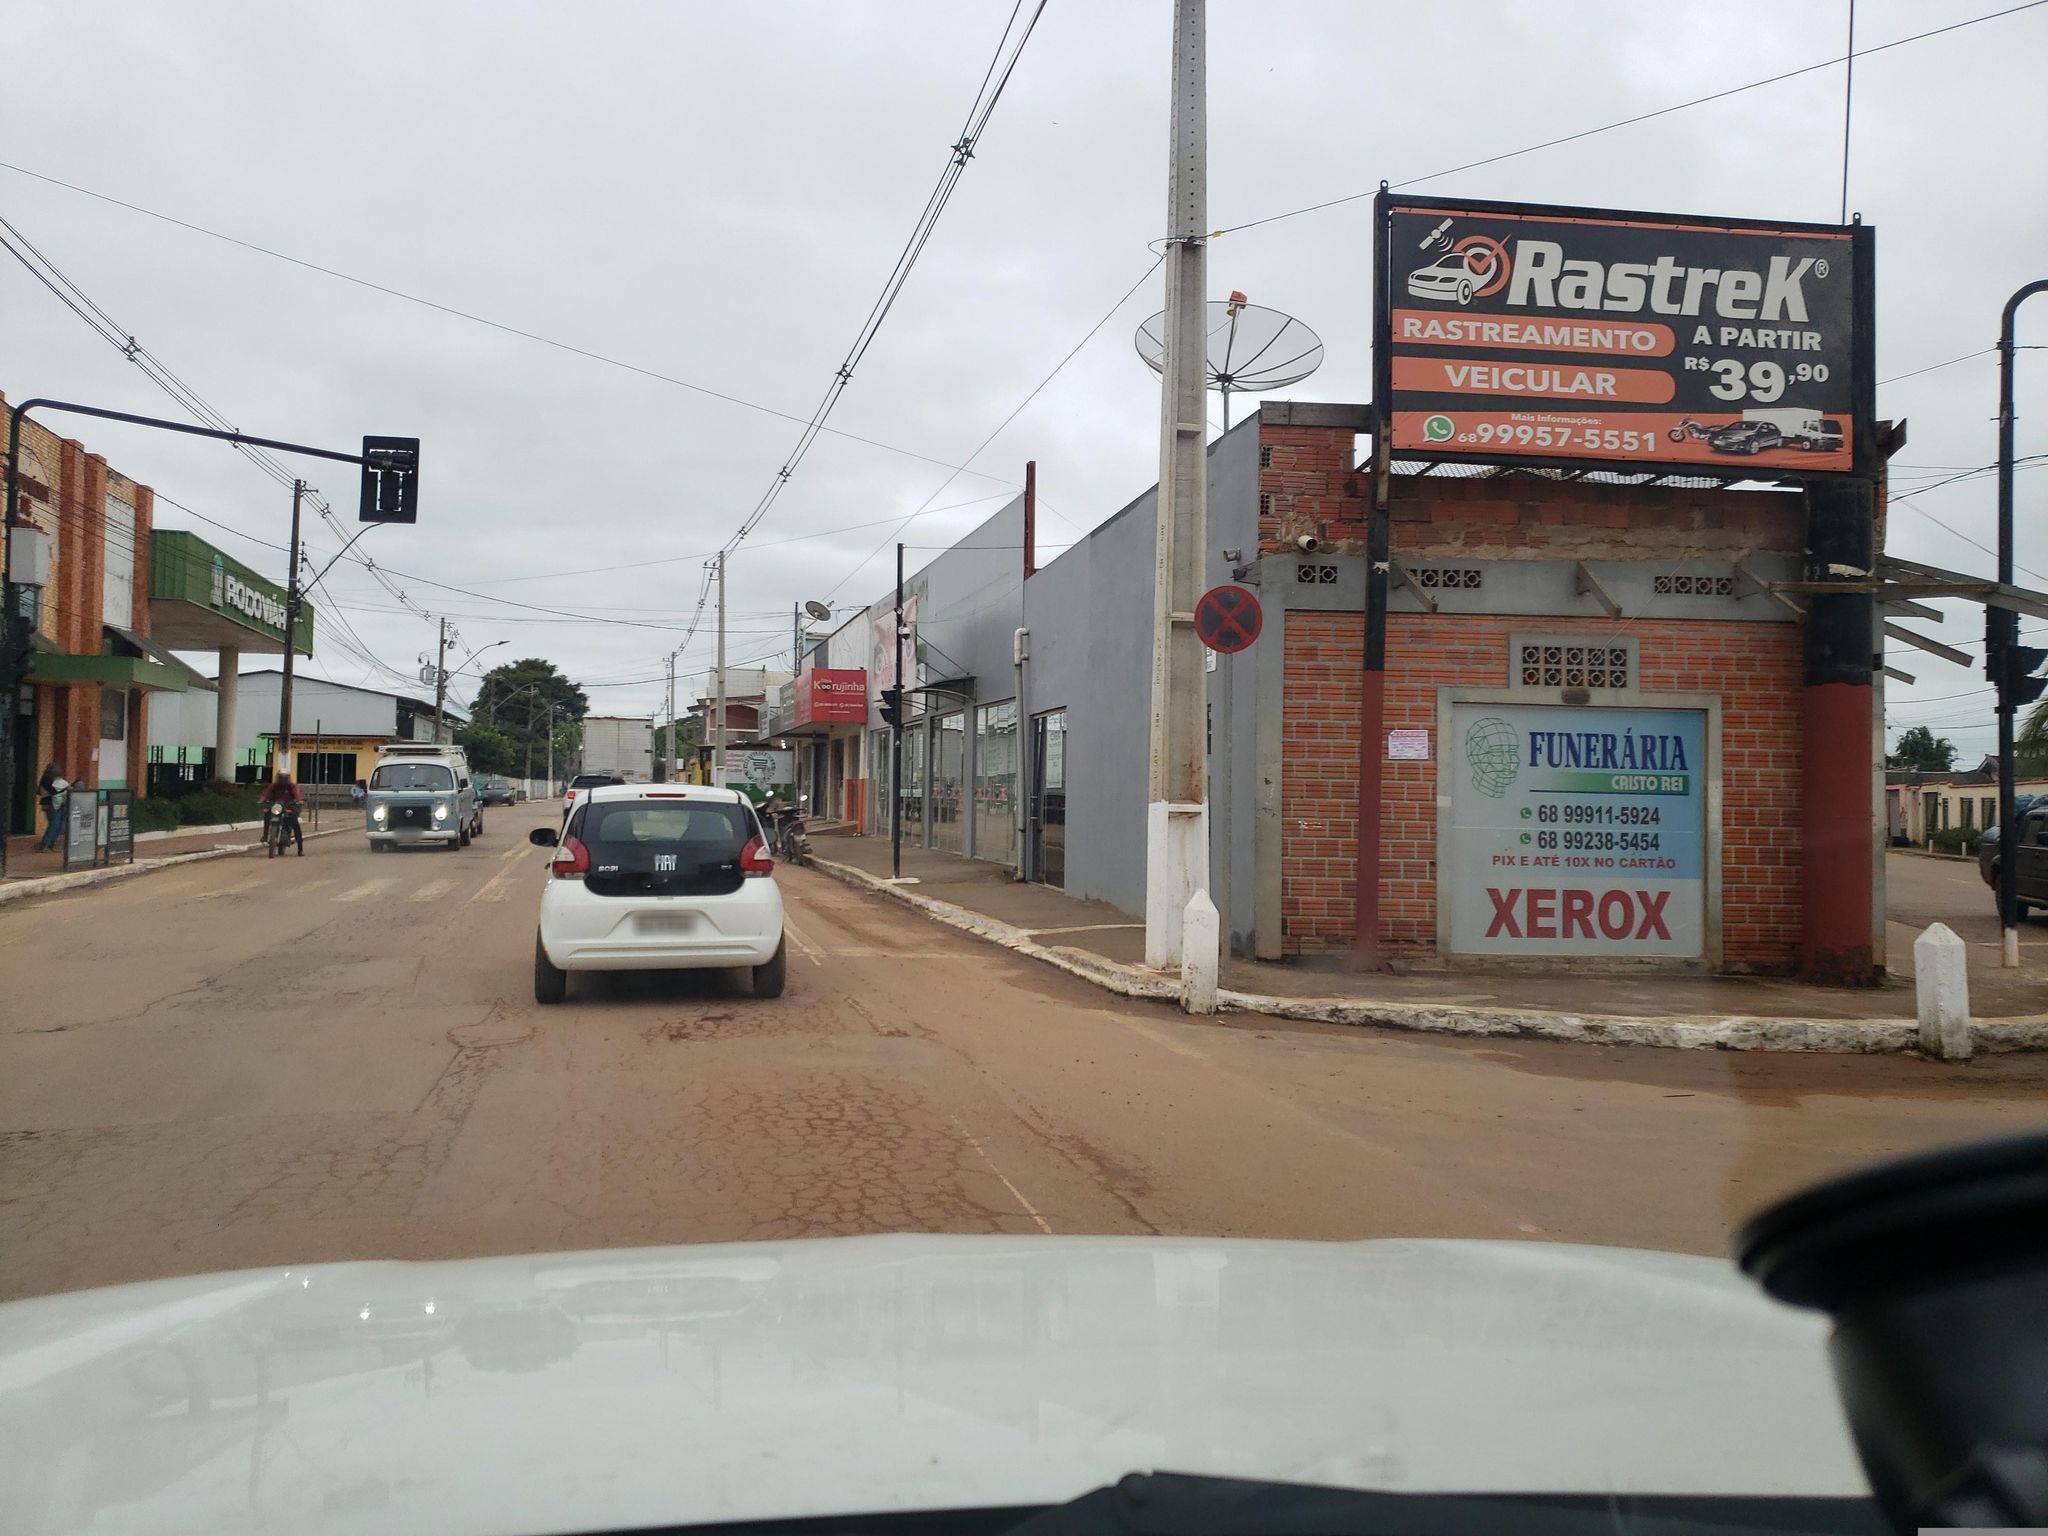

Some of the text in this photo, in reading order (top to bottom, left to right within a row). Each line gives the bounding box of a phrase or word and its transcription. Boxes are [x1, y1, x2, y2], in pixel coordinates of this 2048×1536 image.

[1403, 318, 1656, 351] RASTREAMENTO
[1692, 325, 1822, 350] A PARTIR
[1444, 365, 1617, 395] VEICULAR
[1511, 413, 1535, 422] Mais
[1457, 423, 1655, 452] 68 99957-5551
[224, 574, 289, 631] RODOVIÁR
[1529, 728, 1688, 770] FUNERÁRIA
[1612, 775, 1683, 791] CRISTO REI
[1538, 805, 1660, 825] 68 99911-5924
[1538, 831, 1660, 851] 68 99238-5454
[1492, 854, 1676, 869] PIX E ATÉ 10X NO CARTÃO
[1485, 888, 1673, 941] XEROX
